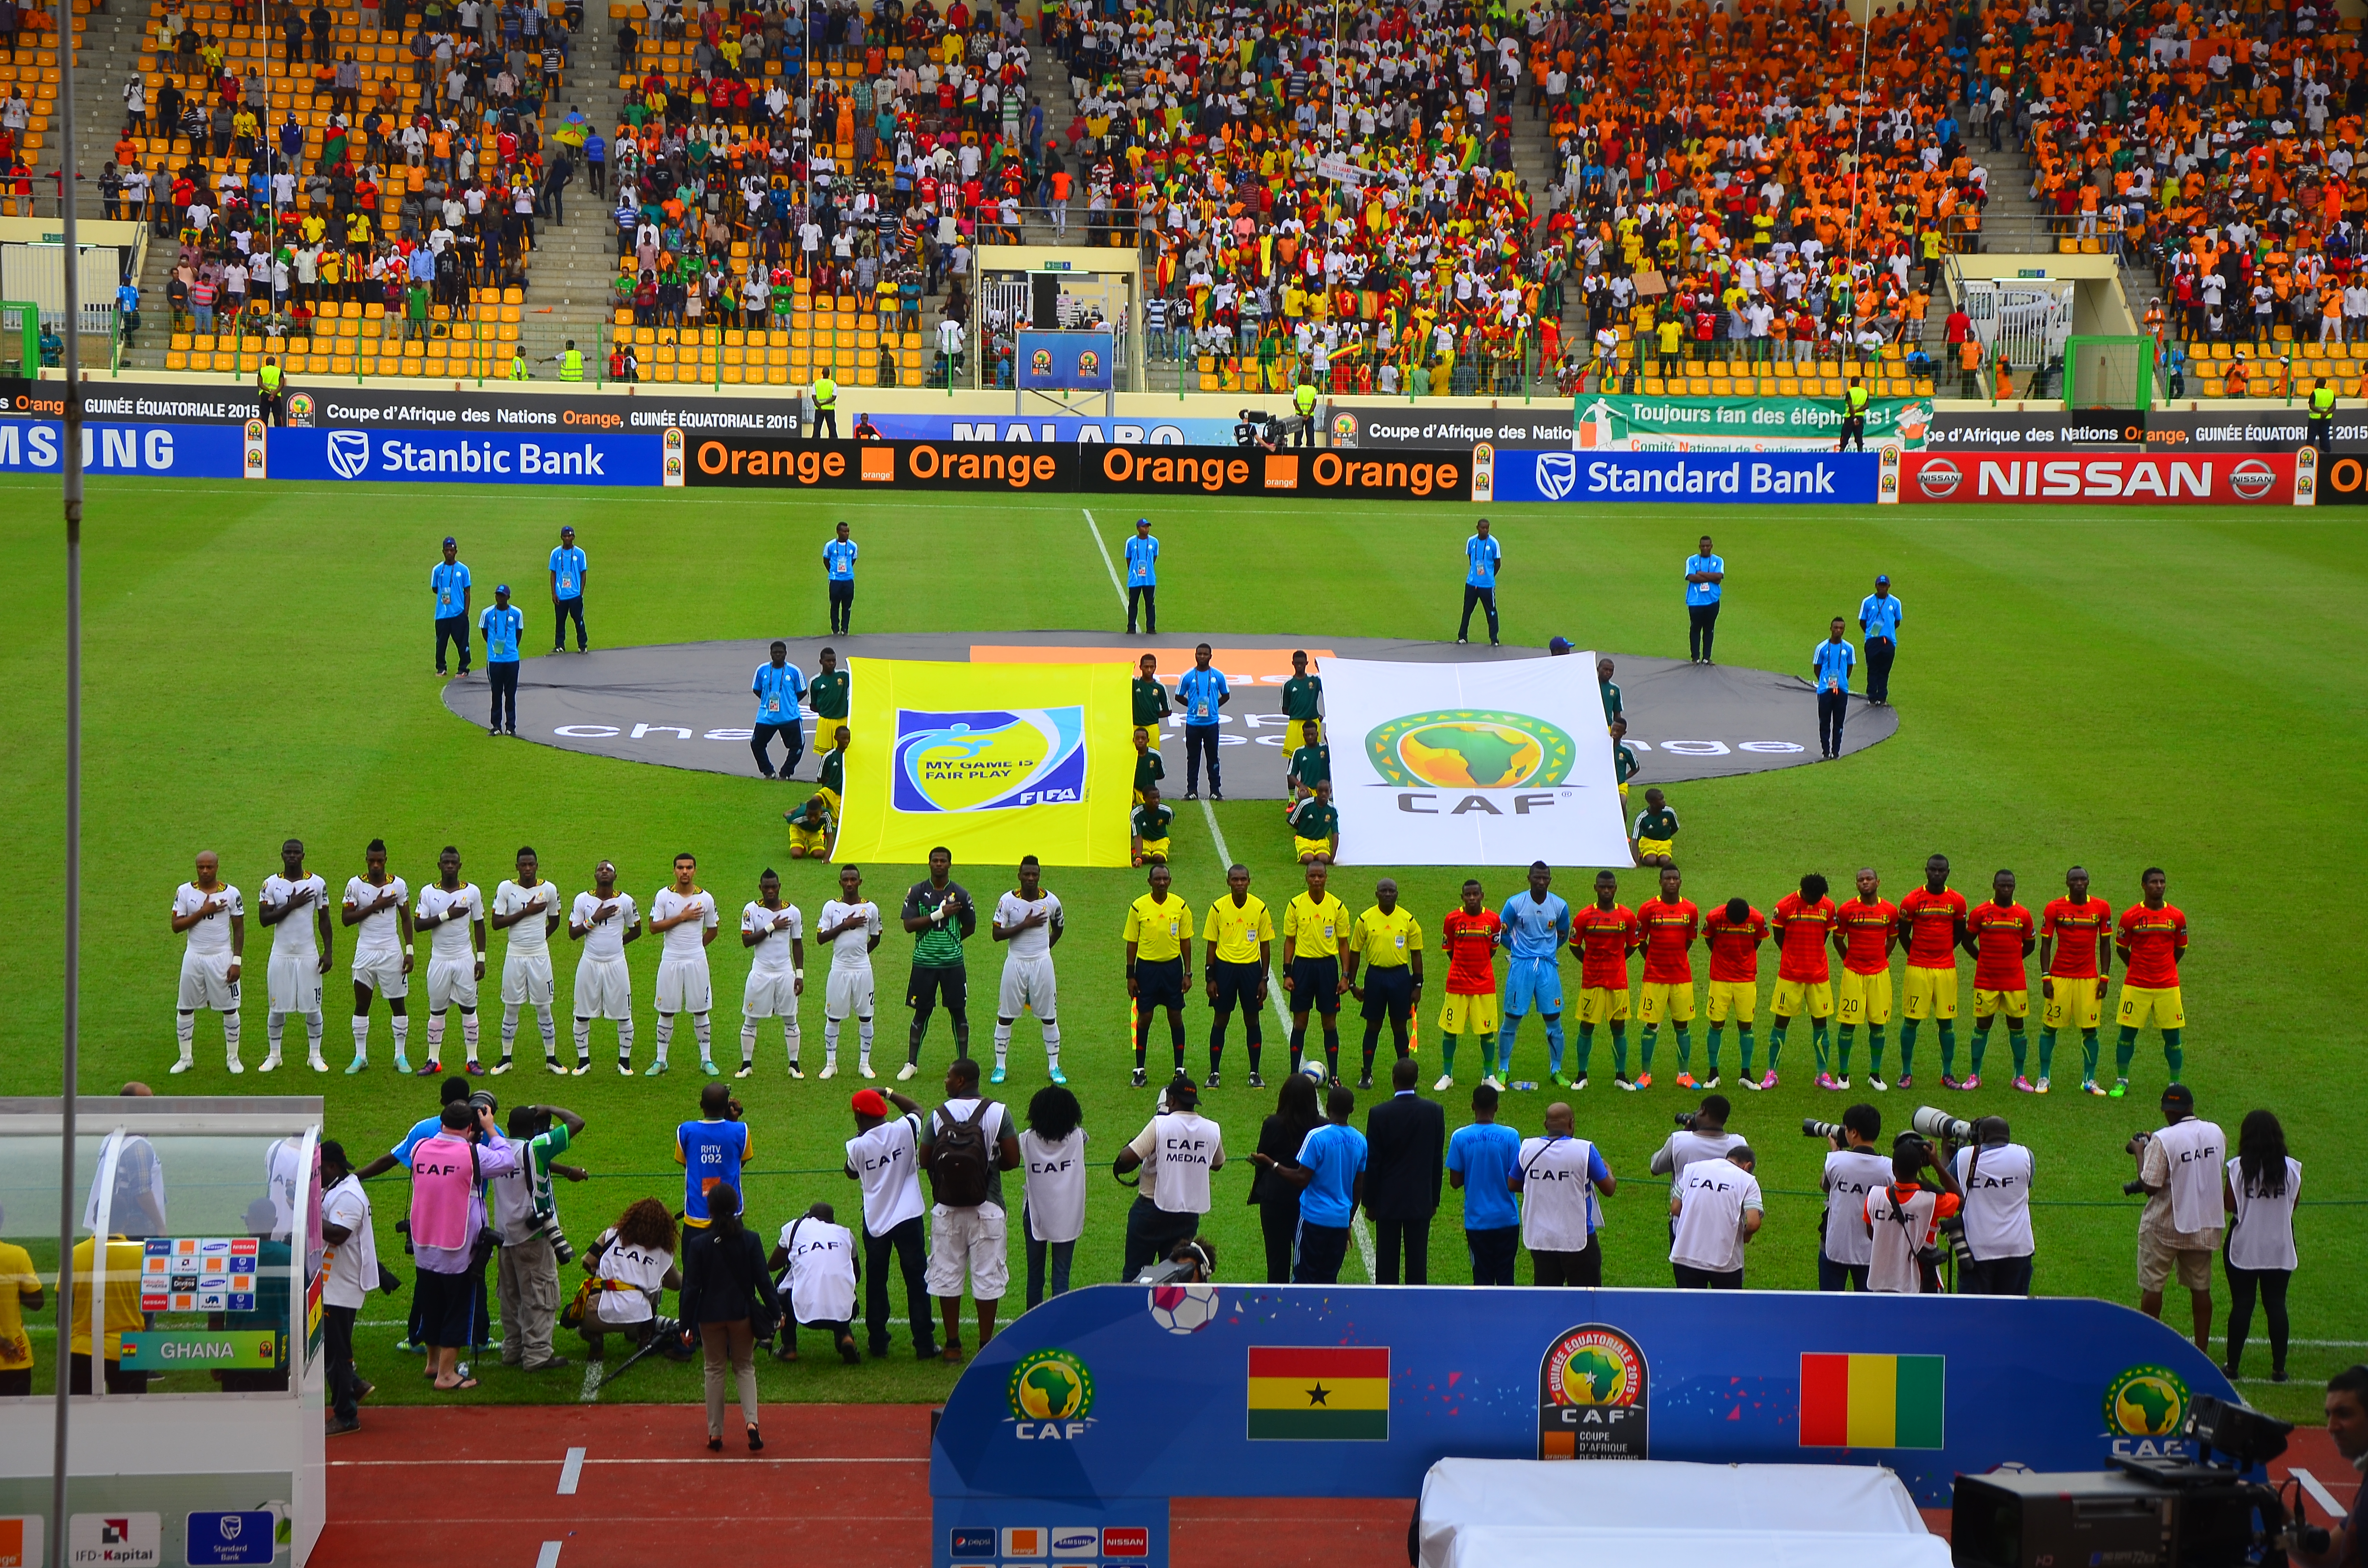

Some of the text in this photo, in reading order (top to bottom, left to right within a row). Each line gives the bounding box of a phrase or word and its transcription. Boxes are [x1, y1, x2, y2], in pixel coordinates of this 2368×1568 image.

[442, 260, 453, 272] 24
[15, 395, 64, 413] Orang
[85, 397, 133, 415] GUINÉE
[136, 399, 225, 417] ÉQUATORIALE
[227, 404, 260, 418] 2015
[327, 404, 379, 423] Coupe
[461, 408, 490, 422] des
[497, 409, 556, 425] Nations
[563, 410, 624, 430] Orange,
[630, 409, 676, 427] GUINÉE
[679, 411, 764, 429] ÉQUATORIALE
[766, 415, 797, 430] 2015
[1631, 403, 1711, 426] Toujours
[1716, 405, 1749, 424] fan
[1752, 405, 1786, 425] des
[1369, 423, 1419, 441] Coupe
[1499, 426, 1526, 441] des
[1532, 425, 1573, 441] Natio
[2025, 428, 2054, 442] des
[2061, 426, 2118, 443] Nations
[2124, 425, 2190, 445] Orange,
[2195, 424, 2243, 441] GUINÉE
[2245, 424, 2333, 442] ÉQUATORIE
[2336, 425, 2368, 440] 2015
[1631, 439, 1675, 452] Comité
[1679, 441, 1730, 452] National
[382, 440, 604, 476] Stanbic Bank
[698, 441, 845, 485] Orange
[909, 445, 1056, 488] Orange
[1103, 448, 1249, 491] Orange
[863, 472, 891, 481] orange
[1312, 453, 1458, 496] Orange
[1588, 460, 1835, 494] Standard Bank
[1979, 461, 2213, 498] NISSAN
[1265, 478, 1295, 488] orange
[925, 759, 1034, 770] MY GAME IS
[925, 769, 1011, 780] FAIR PLAY
[1020, 787, 1076, 805] FIFA
[228, 983, 239, 998] 10
[1583, 997, 1591, 1010] 7
[1643, 997, 1653, 1011] 13
[1779, 992, 1786, 1004] 11
[1842, 998, 1859, 1012] 20
[1910, 995, 1920, 1008] 17
[1975, 992, 1983, 1005] 5
[2047, 1003, 2061, 1018] 23
[2122, 1000, 2134, 1014] 10
[1446, 1008, 1453, 1021] 8
[1166, 1139, 1205, 1151] CAF
[1466, 1131, 1505, 1145] VOLUNTEER
[701, 1145, 721, 1153] RHTV
[2180, 1147, 2215, 1162] CAF
[701, 1153, 722, 1163] 092
[865, 1148, 902, 1170] CAF
[1166, 1153, 1207, 1164] MEDIA
[415, 1163, 454, 1176] CAF
[1031, 1160, 1071, 1173] CAF
[1529, 1169, 1569, 1181] CAF
[1972, 1176, 2014, 1188] CAF
[1690, 1178, 1730, 1192] CAF
[2245, 1188, 2286, 1199] CAF
[797, 1241, 839, 1255] CAF
[613, 1246, 654, 1265] CAF
[160, 1341, 235, 1359] GHANA
[1550, 1334, 1638, 1394] GUINÉE ÉQUATORIALE 2015
[1562, 1409, 1625, 1423] CAF
[1015, 1422, 1085, 1440] CAF
[1579, 1431, 1610, 1441] COUPE
[213, 1544, 247, 1553] Standard
[968, 1537, 990, 1546] pepsi
[75, 1549, 153, 1563] IFD-Kapital
[221, 1554, 240, 1562] Bank
